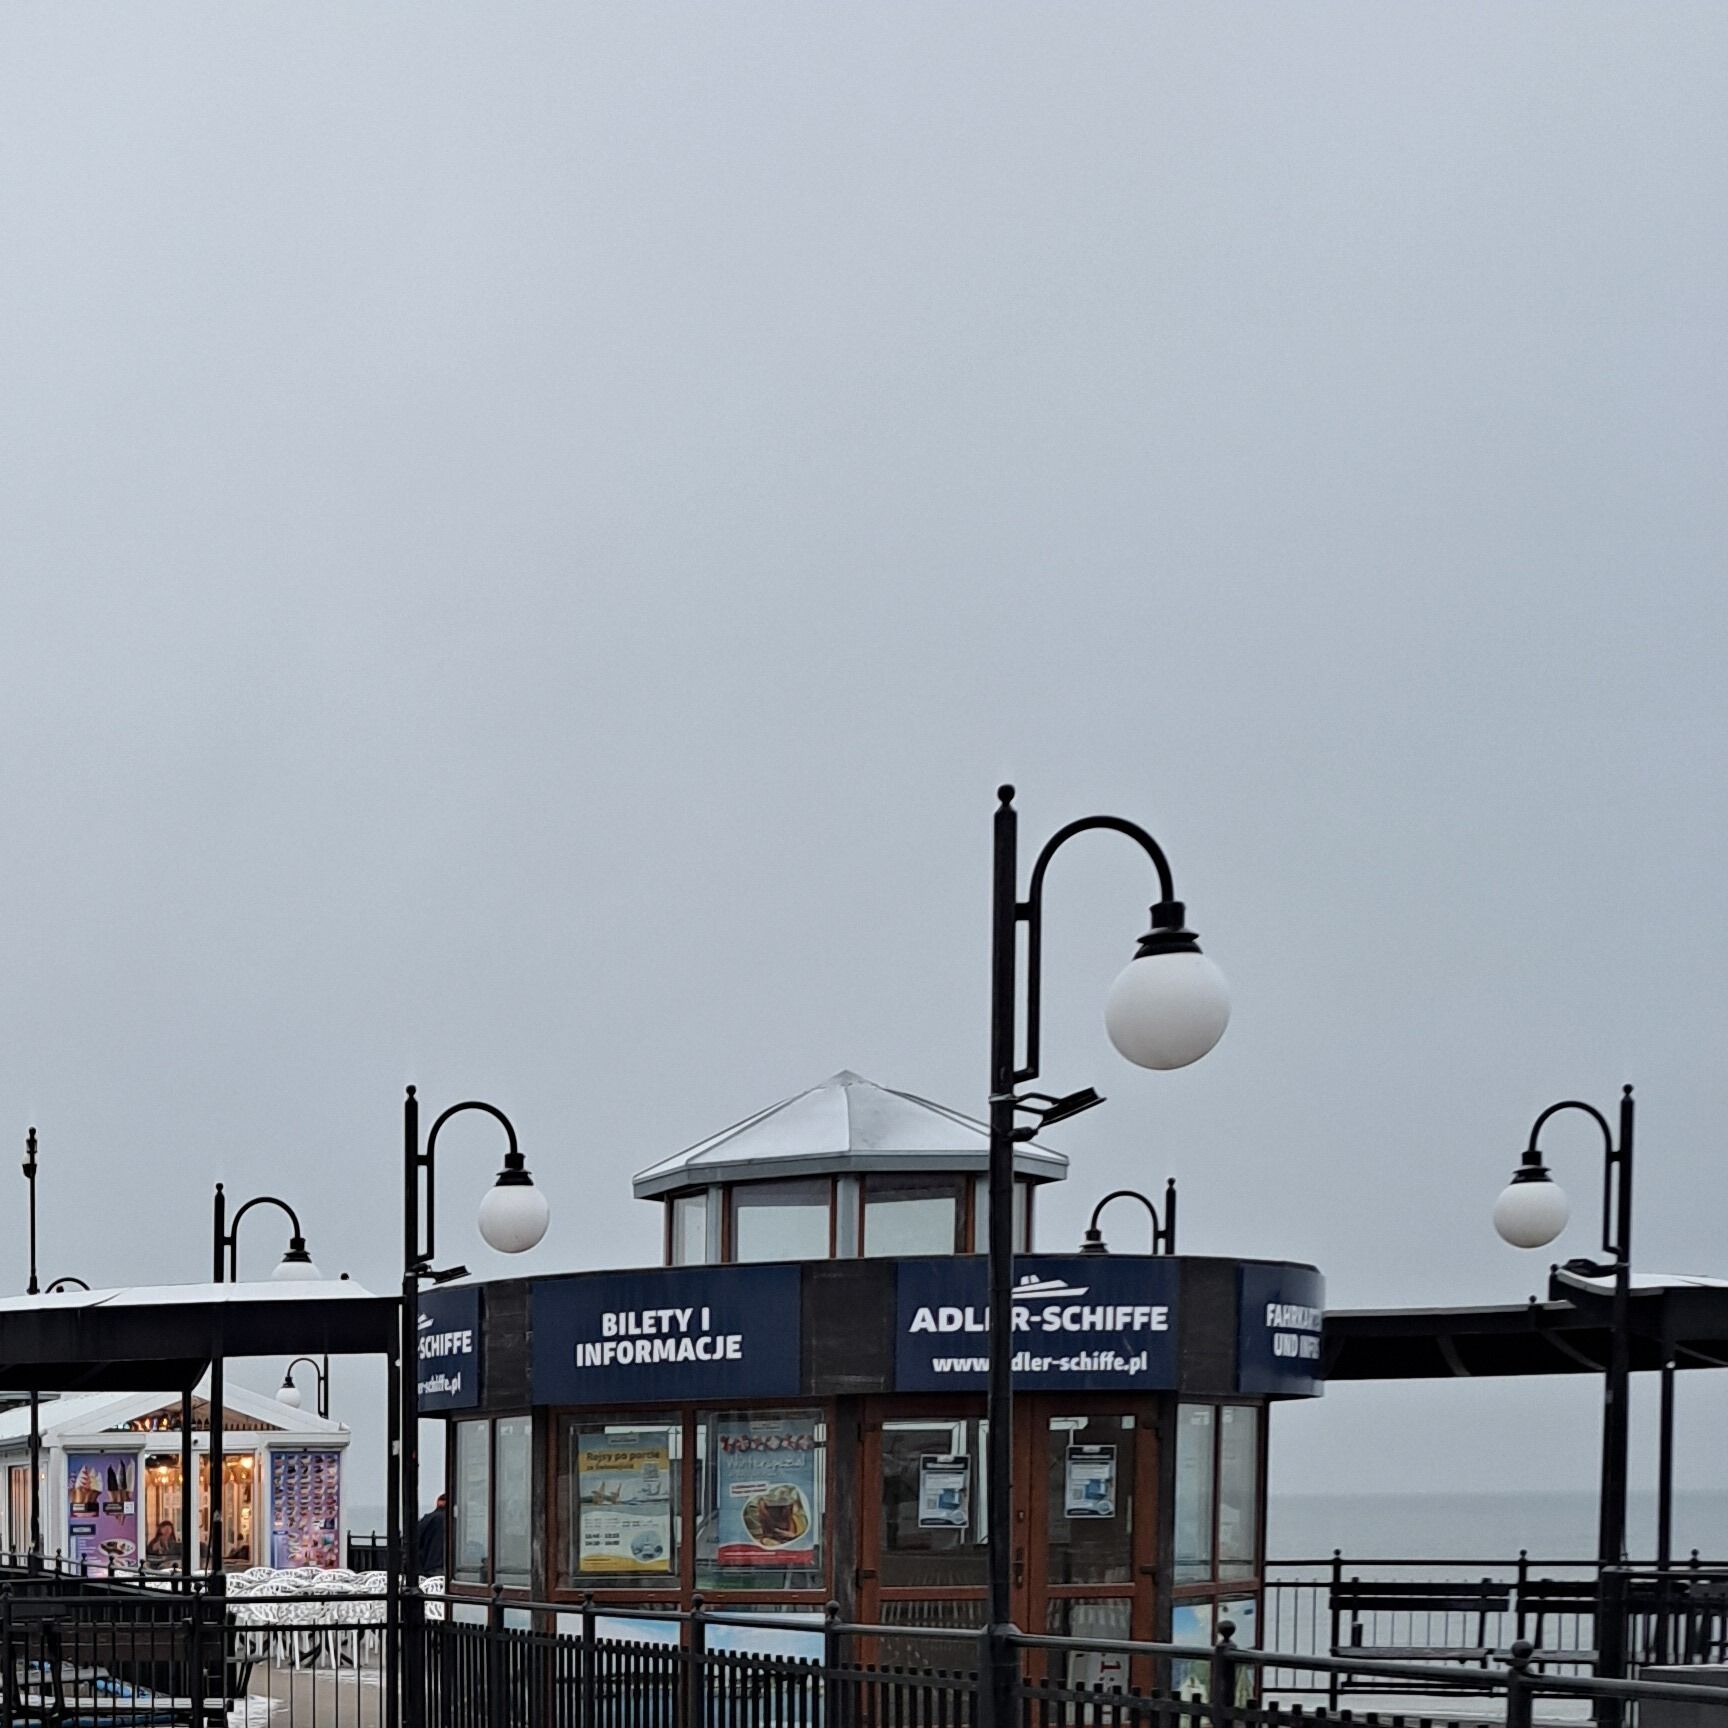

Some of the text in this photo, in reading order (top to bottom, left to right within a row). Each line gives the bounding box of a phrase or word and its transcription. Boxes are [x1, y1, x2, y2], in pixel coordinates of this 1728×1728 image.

[602, 1306, 710, 1337] BILETY I
[908, 1305, 1169, 1333] ADLR-SCHIFFE
[576, 1334, 743, 1367] INFORMACJE
[932, 1351, 1148, 1375] wwwdler-schiffe.pl
